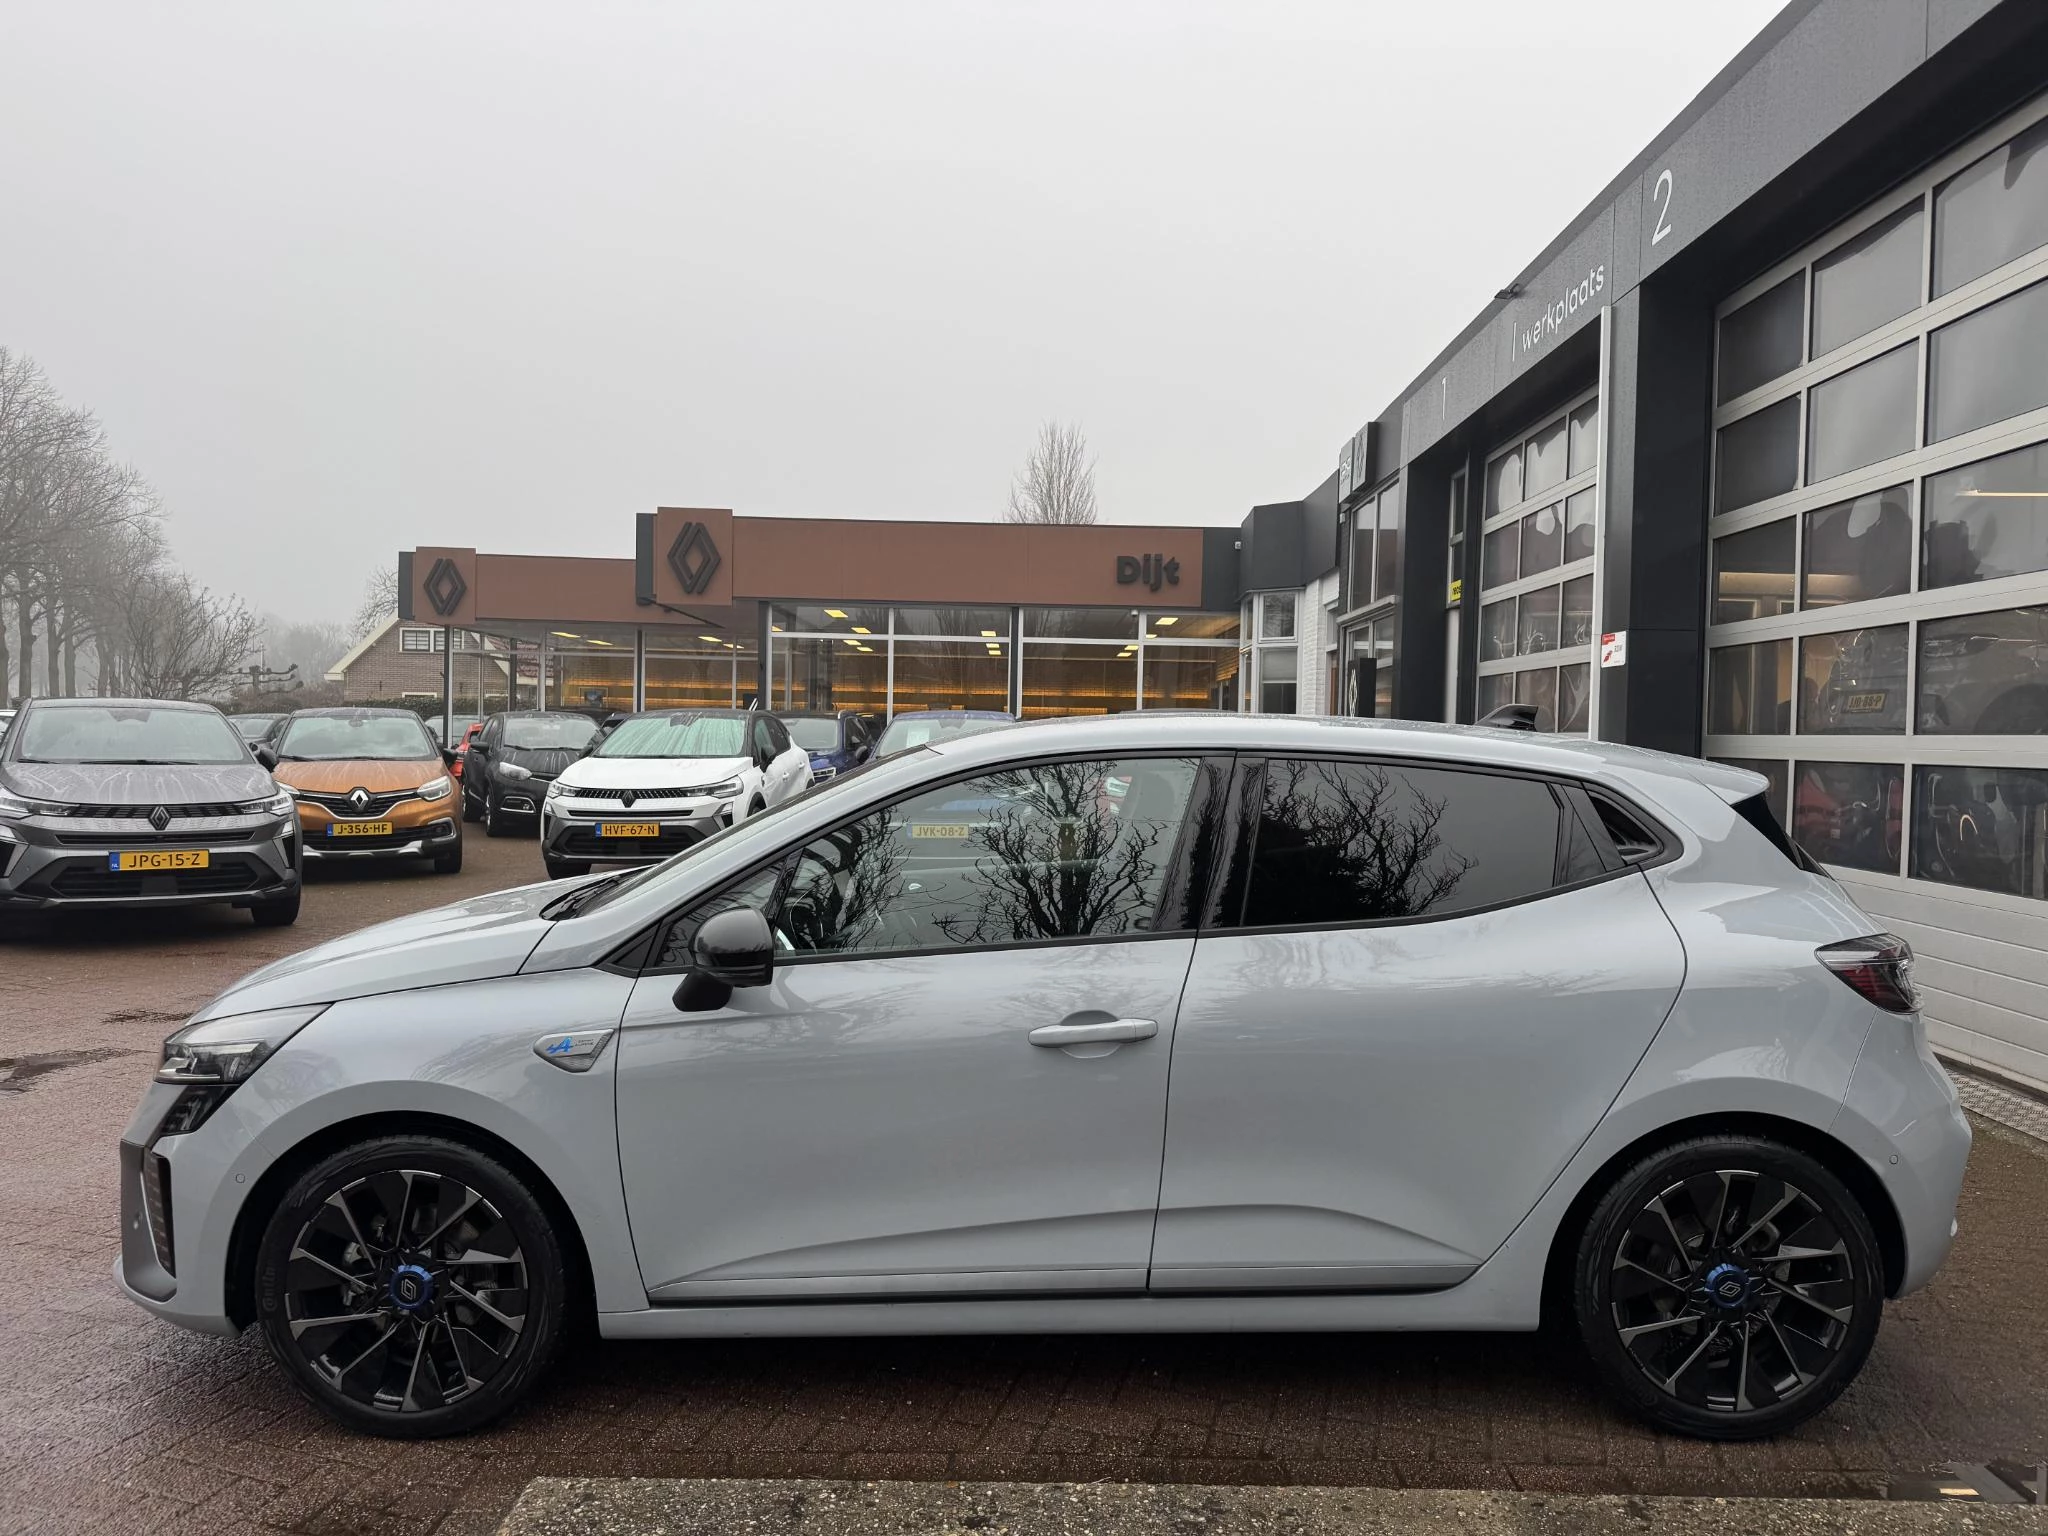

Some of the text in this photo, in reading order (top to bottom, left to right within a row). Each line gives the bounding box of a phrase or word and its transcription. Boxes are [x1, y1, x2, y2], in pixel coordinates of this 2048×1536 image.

[1652, 169, 1672, 247] 2
[1522, 264, 1604, 352] werkplaats
[337, 823, 388, 834] J-356-HF
[604, 825, 655, 835] HVF-67-N
[128, 853, 200, 868] JPG-15-Z
